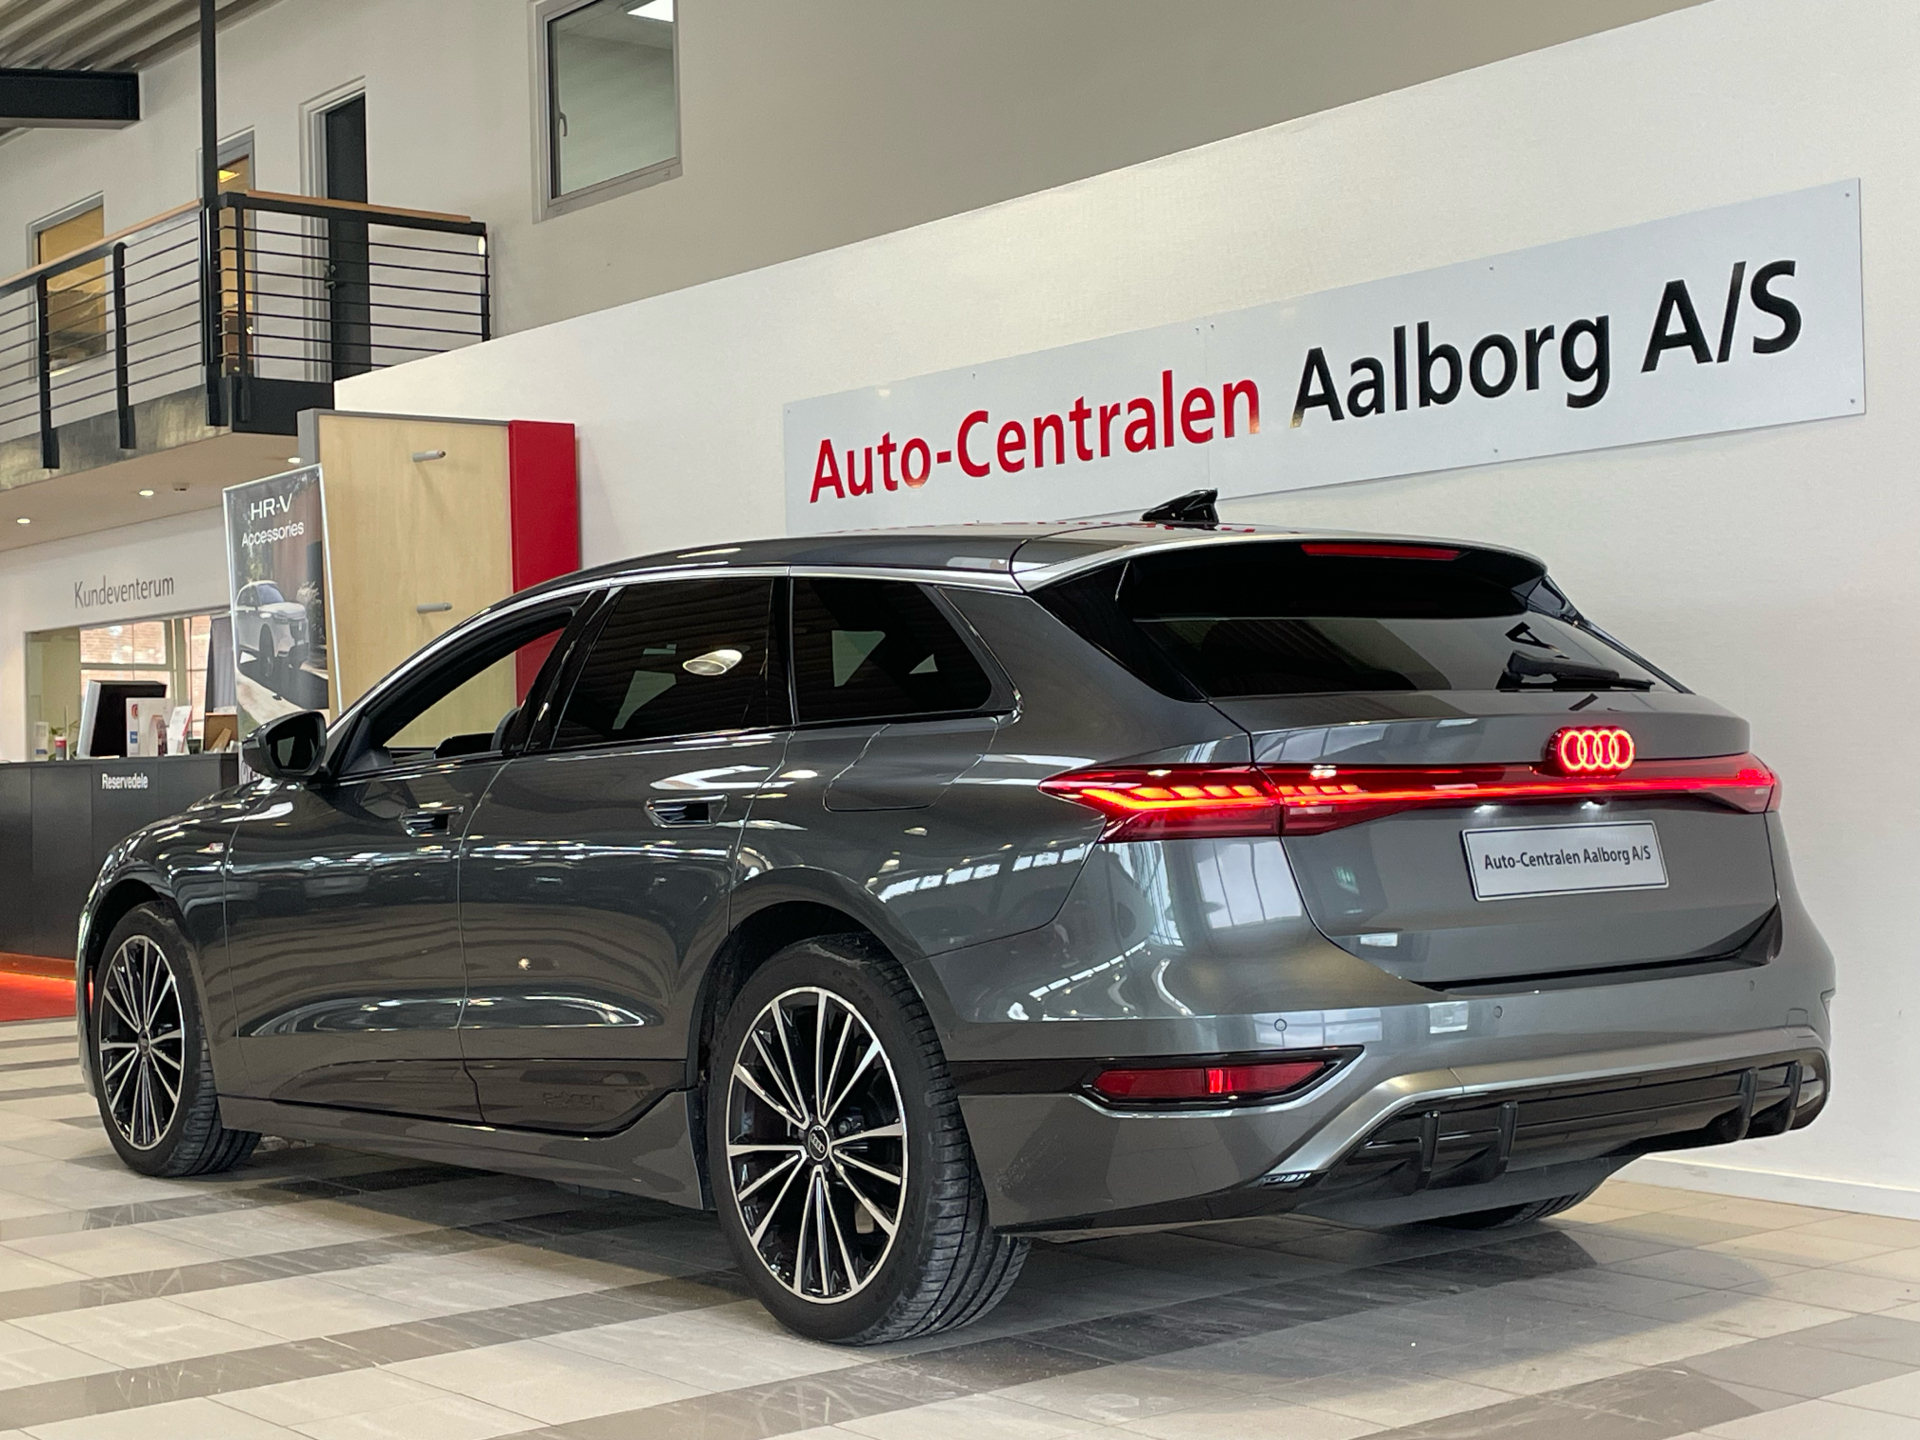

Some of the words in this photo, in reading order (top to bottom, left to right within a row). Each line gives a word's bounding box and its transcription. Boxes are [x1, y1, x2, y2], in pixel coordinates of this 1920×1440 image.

[809, 369, 1260, 503] Auto-Centralen
[1289, 315, 1610, 428] Aalborg
[1641, 259, 1802, 373] A/S
[250, 493, 293, 520] HR-V
[241, 520, 305, 547] Accessories
[74, 575, 174, 608] Kundeventerum
[101, 772, 149, 789] Reservedele
[1484, 849, 1581, 870] Auto-Centralen
[1583, 847, 1630, 865] Aalborg
[1632, 845, 1651, 861] A/S
